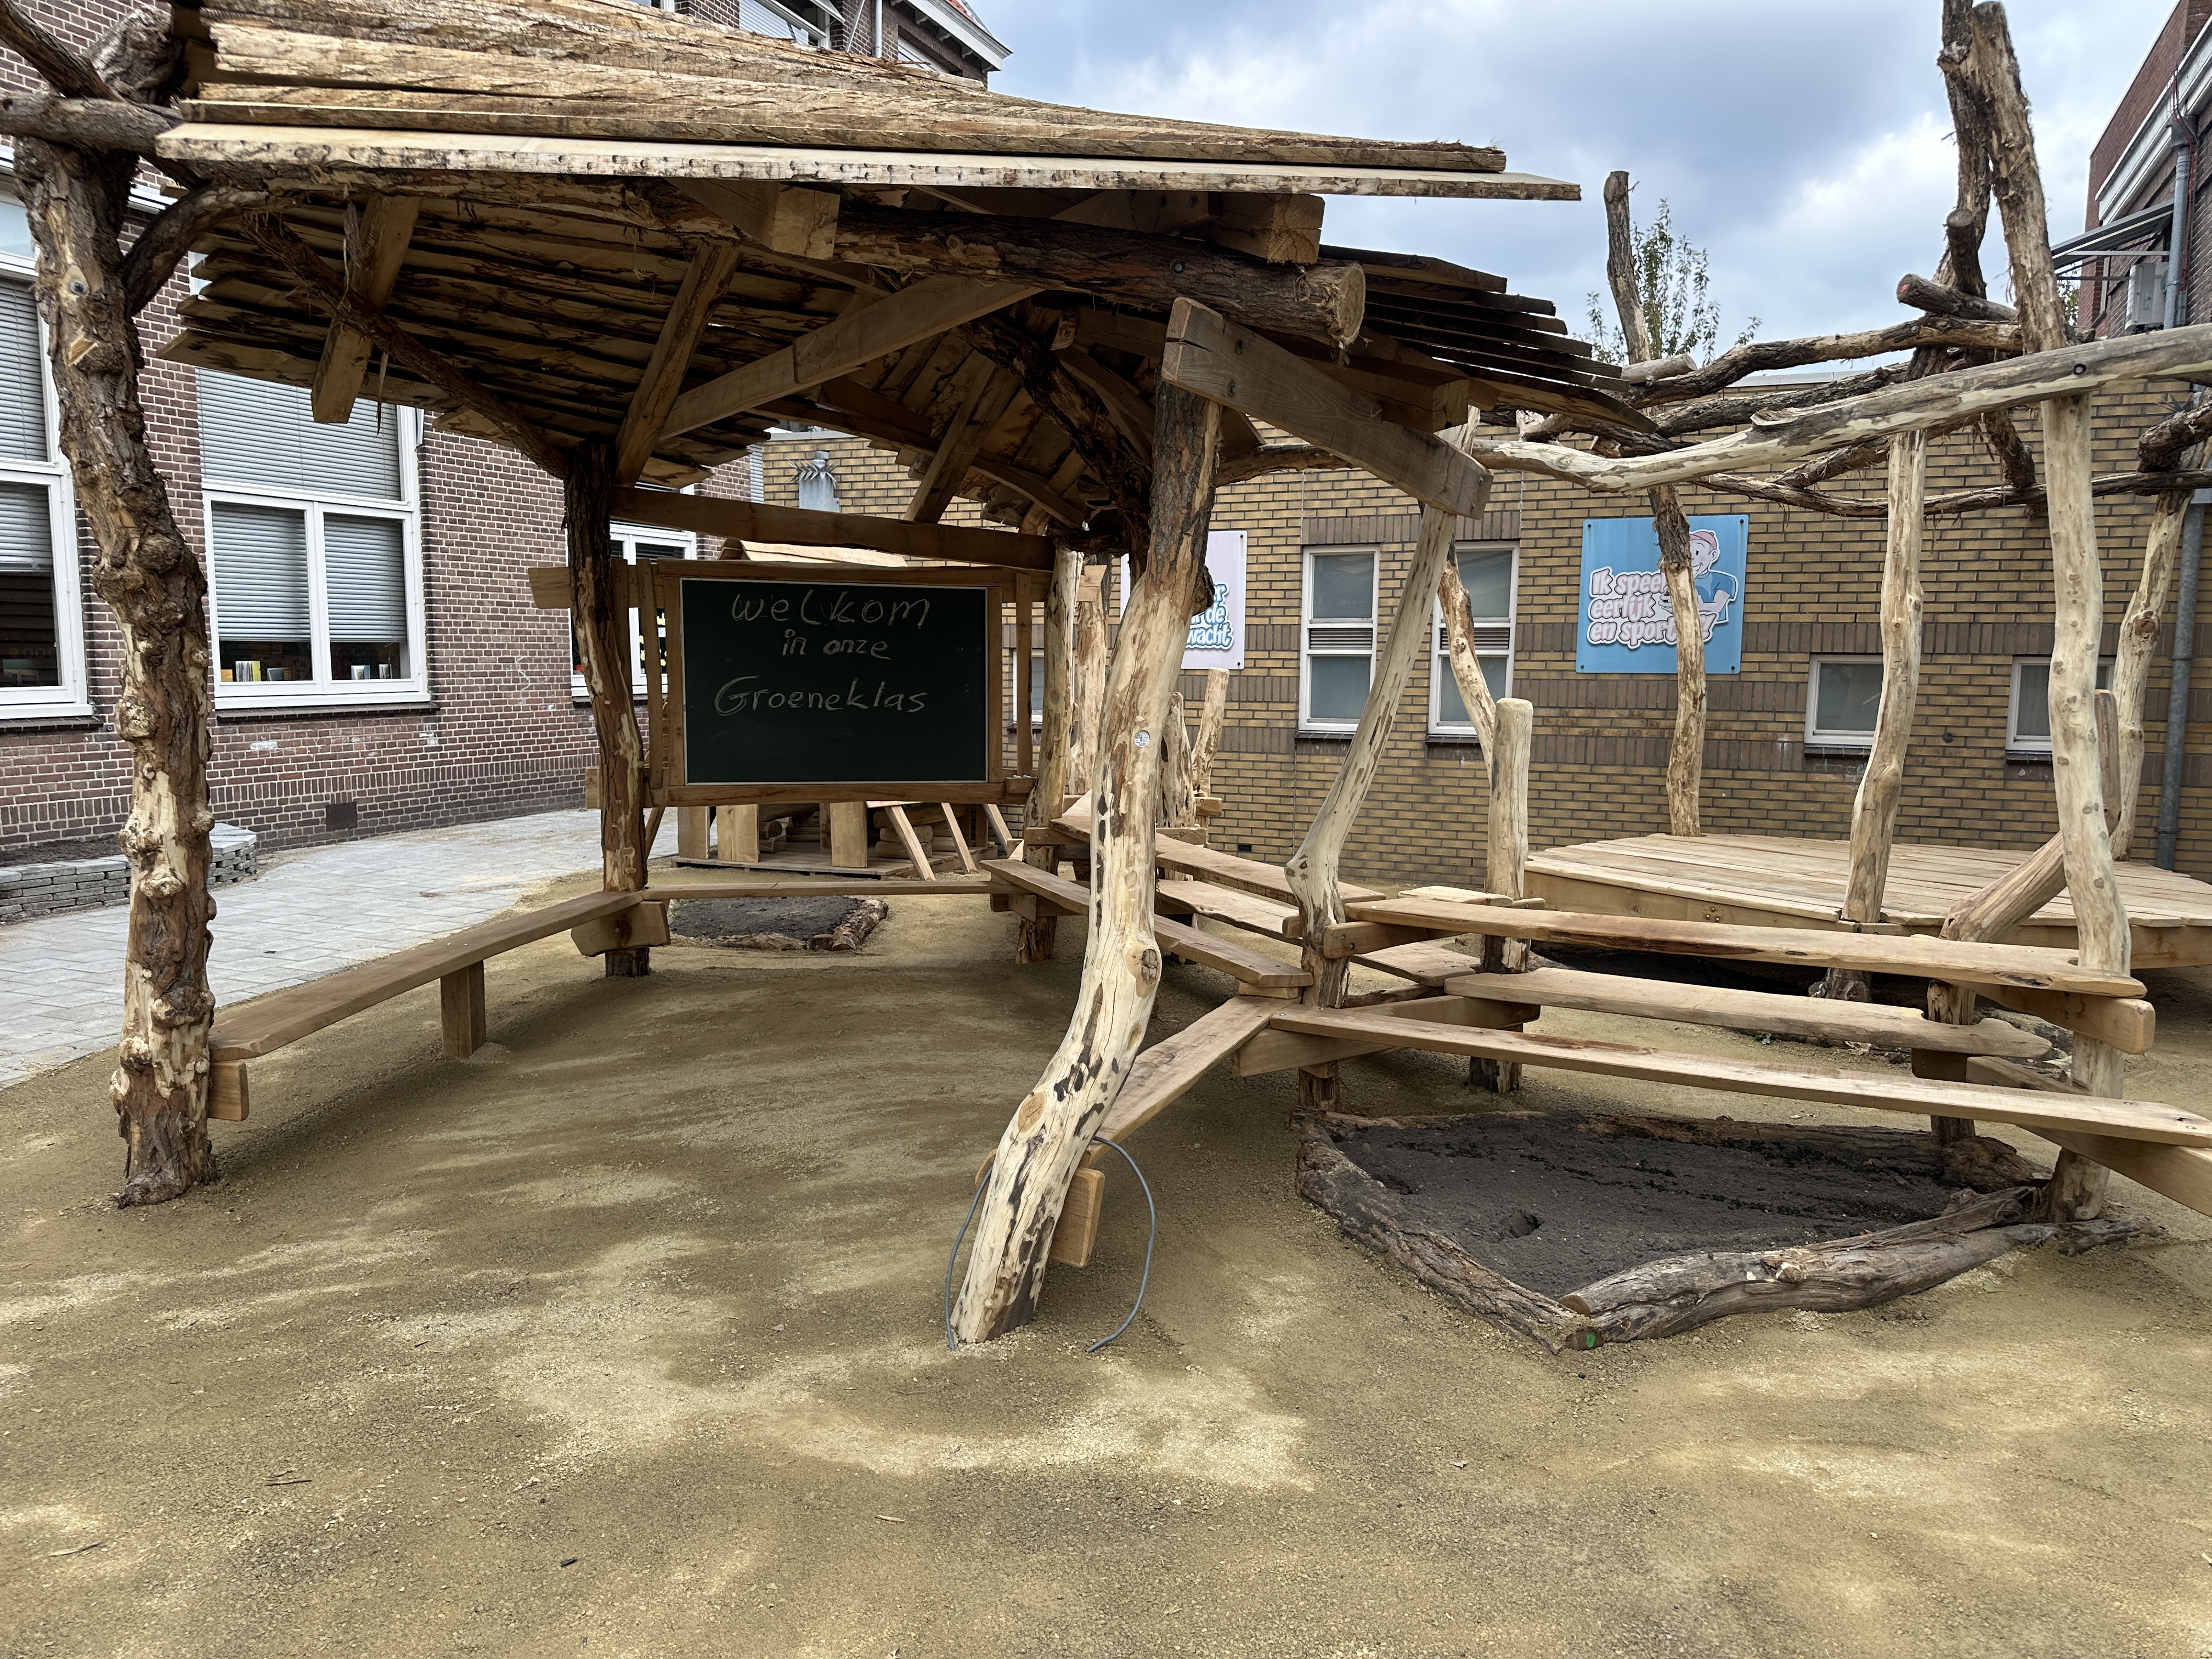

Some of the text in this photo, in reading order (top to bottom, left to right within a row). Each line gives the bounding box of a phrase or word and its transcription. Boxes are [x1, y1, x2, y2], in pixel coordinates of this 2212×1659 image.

[1592, 569, 1613, 595] Ik
[1205, 601, 1226, 624] de
[1590, 592, 1656, 622] eerlijk
[1589, 622, 1617, 641] en
[782, 629, 893, 661] in onze
